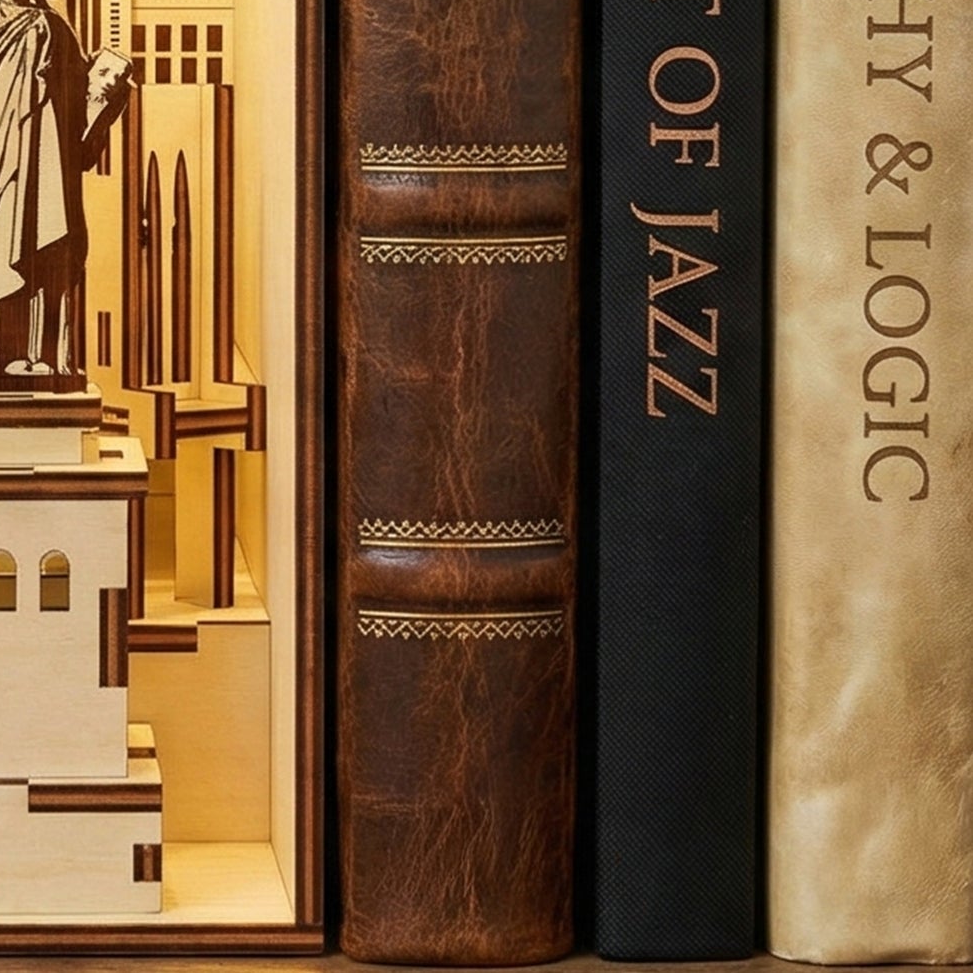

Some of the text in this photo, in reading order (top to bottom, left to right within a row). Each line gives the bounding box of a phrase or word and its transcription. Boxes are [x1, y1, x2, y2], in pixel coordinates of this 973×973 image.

[648, 45, 721, 167] OF
[865, 133, 934, 195] &
[630, 202, 719, 418] JAZZ
[862, 223, 932, 503] LOGIC
